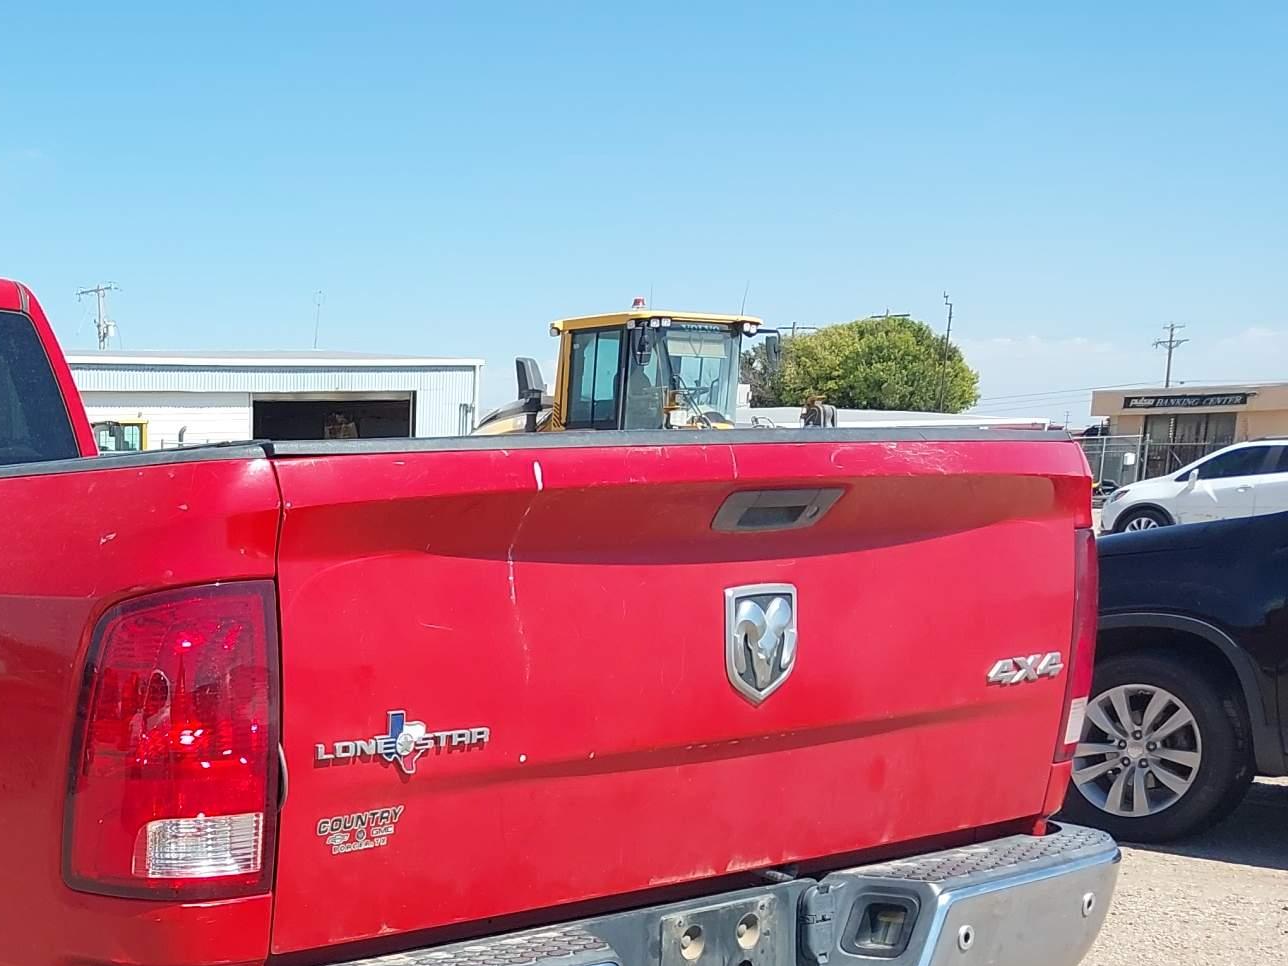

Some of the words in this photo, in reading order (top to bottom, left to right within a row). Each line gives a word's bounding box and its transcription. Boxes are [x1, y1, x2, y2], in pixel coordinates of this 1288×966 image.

[1201, 395, 1242, 406] CENTER
[317, 805, 404, 836] COUNTRY
[371, 825, 394, 837] GMC
